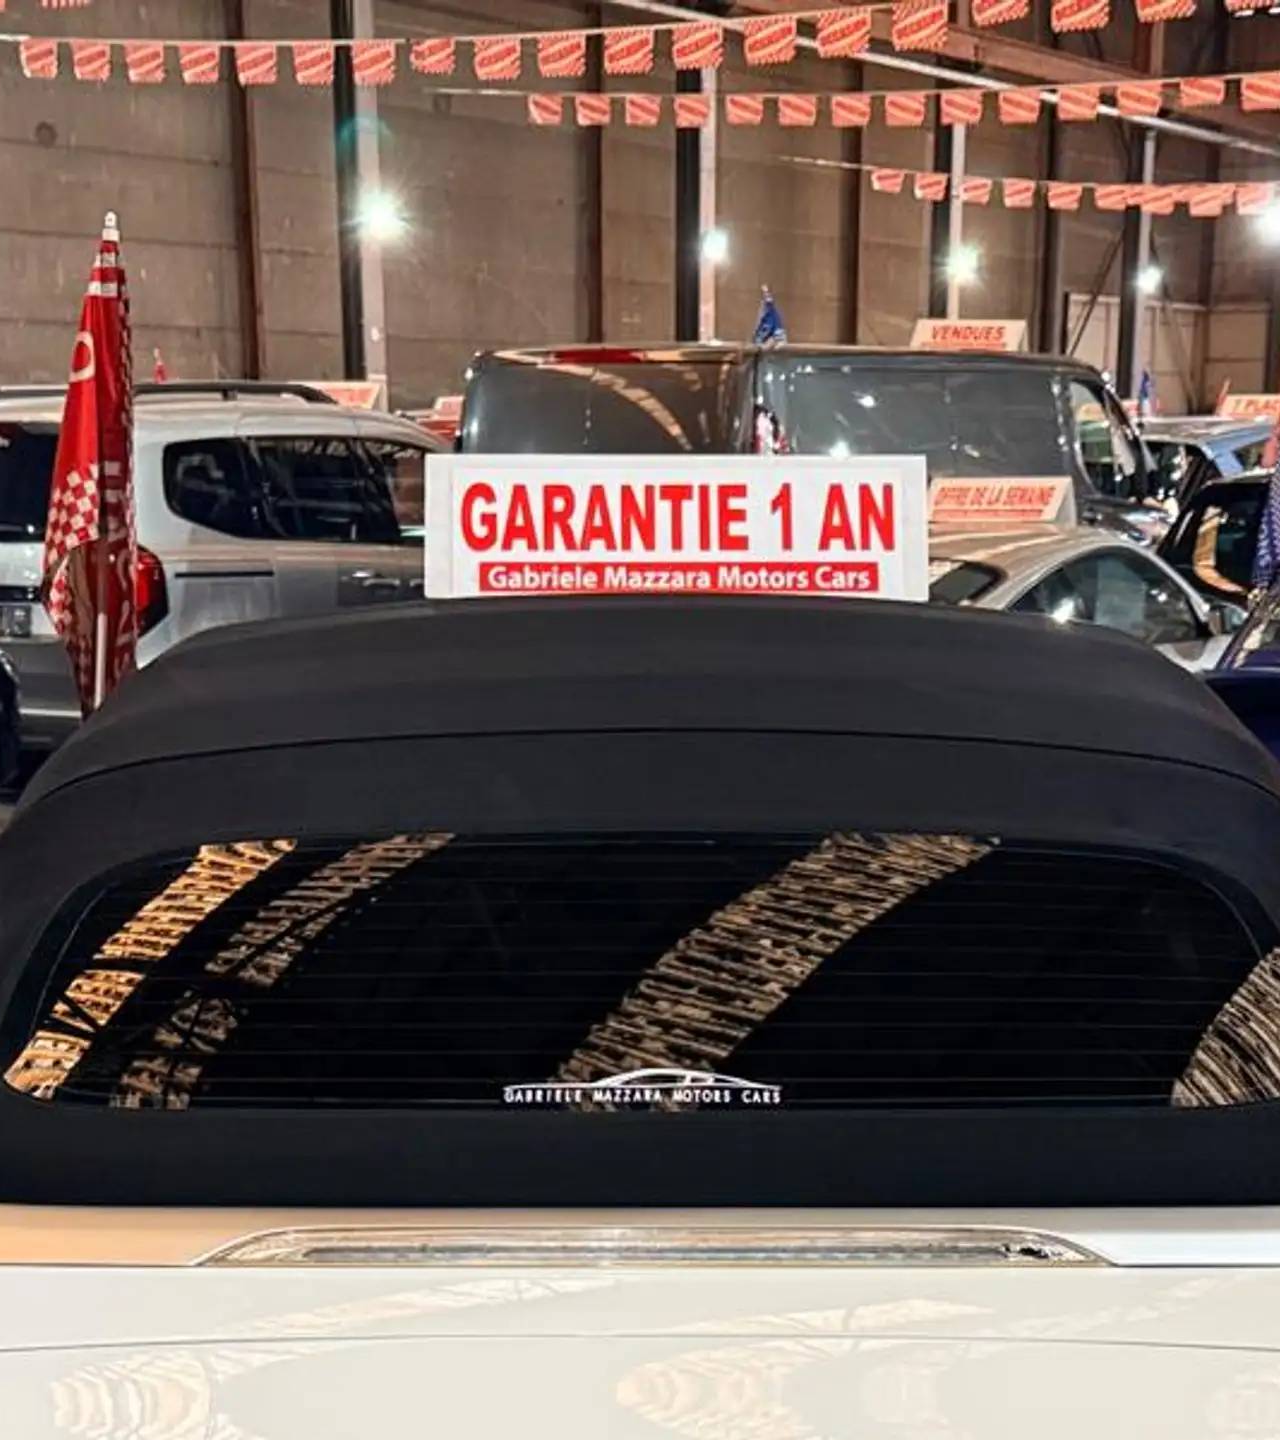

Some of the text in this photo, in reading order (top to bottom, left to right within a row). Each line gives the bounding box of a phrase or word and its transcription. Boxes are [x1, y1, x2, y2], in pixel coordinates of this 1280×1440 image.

[932, 325, 1005, 341] VENDUES
[460, 481, 896, 552] GARANTIE 1 AN
[487, 565, 871, 591] Gabriele Mazzara Motors Cars
[504, 1087, 781, 1104] GABRIELE MAZZARA MOTORS CARS
